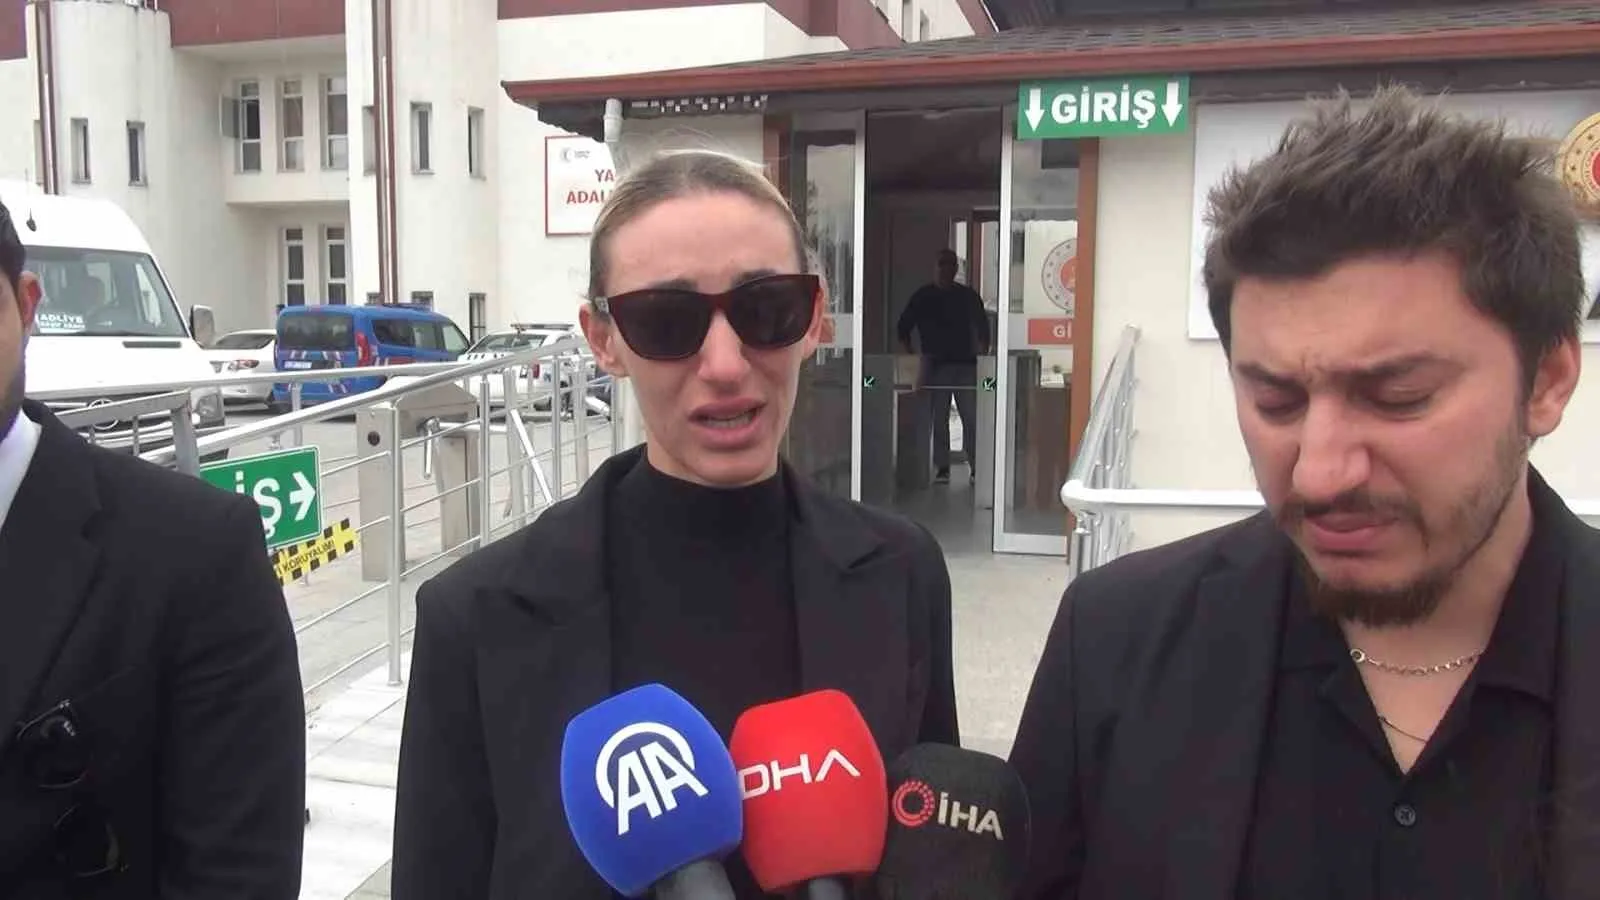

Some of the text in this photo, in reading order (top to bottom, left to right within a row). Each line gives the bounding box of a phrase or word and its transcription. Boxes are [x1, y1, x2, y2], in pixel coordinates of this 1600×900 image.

[1051, 83, 1156, 129] GİRİŞ
[566, 189, 612, 205] ADAL
[617, 741, 709, 836] AA
[737, 749, 861, 801] DHA
[938, 791, 1004, 841] İHA
